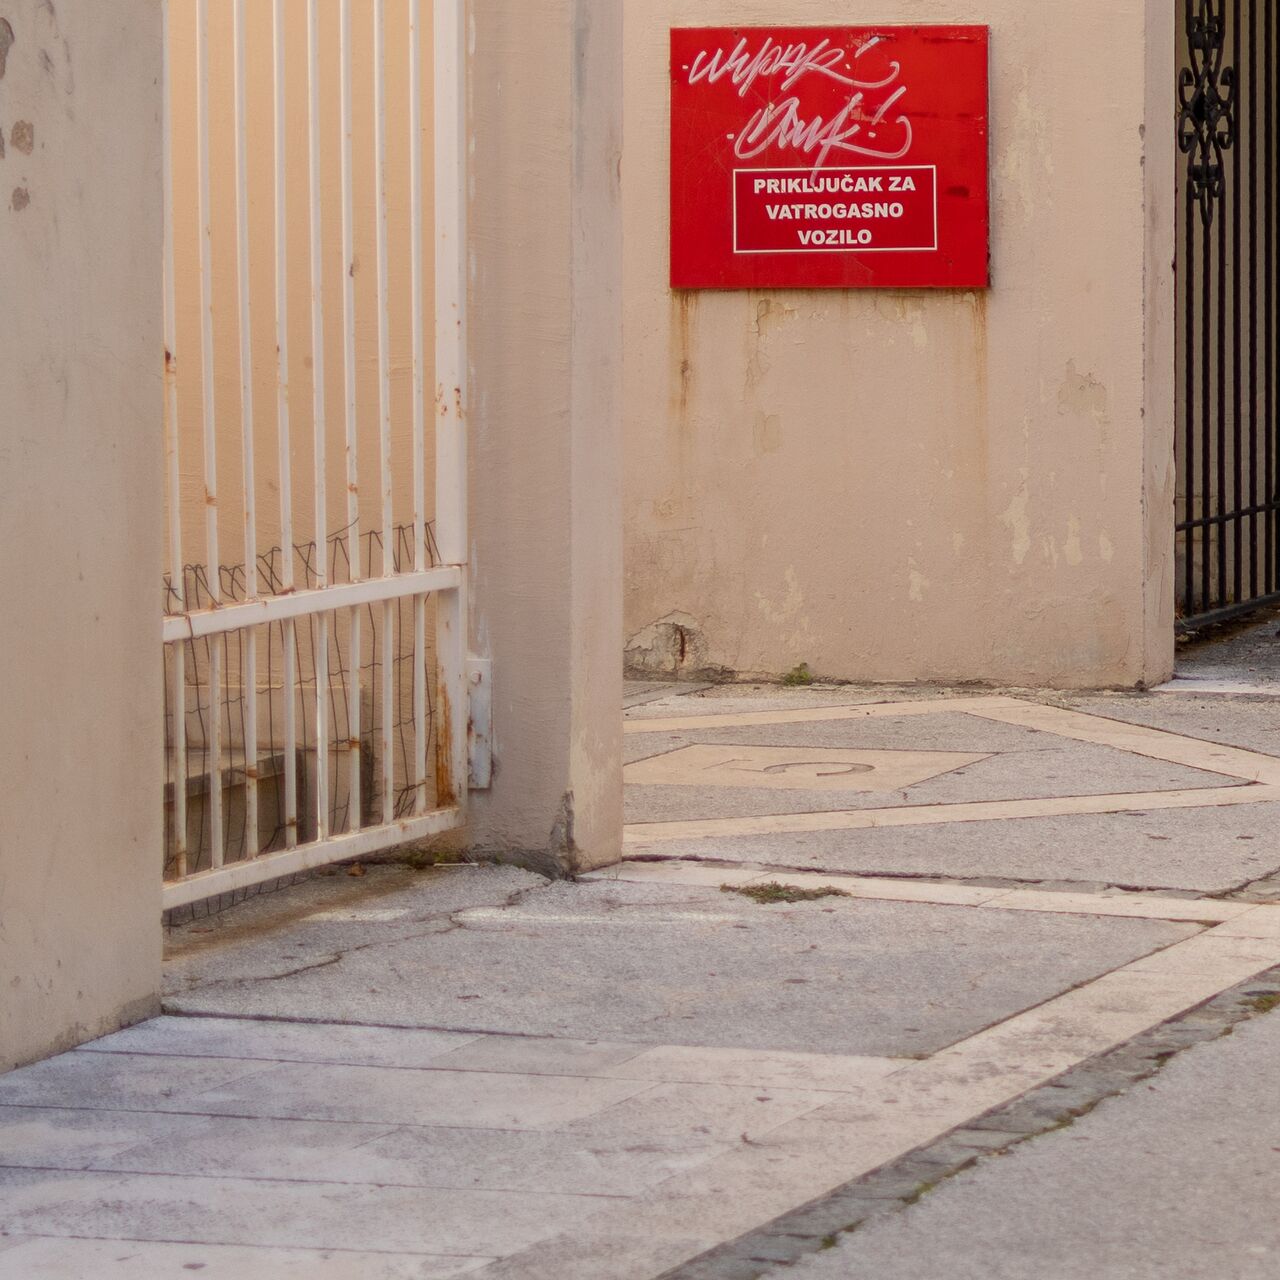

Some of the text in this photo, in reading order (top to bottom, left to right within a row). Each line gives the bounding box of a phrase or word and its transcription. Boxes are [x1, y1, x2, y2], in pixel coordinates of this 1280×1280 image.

[753, 174, 916, 194] PRIKLJUČAK ZA
[765, 203, 904, 220] VATROGASNO
[797, 229, 872, 245] VOZILO
